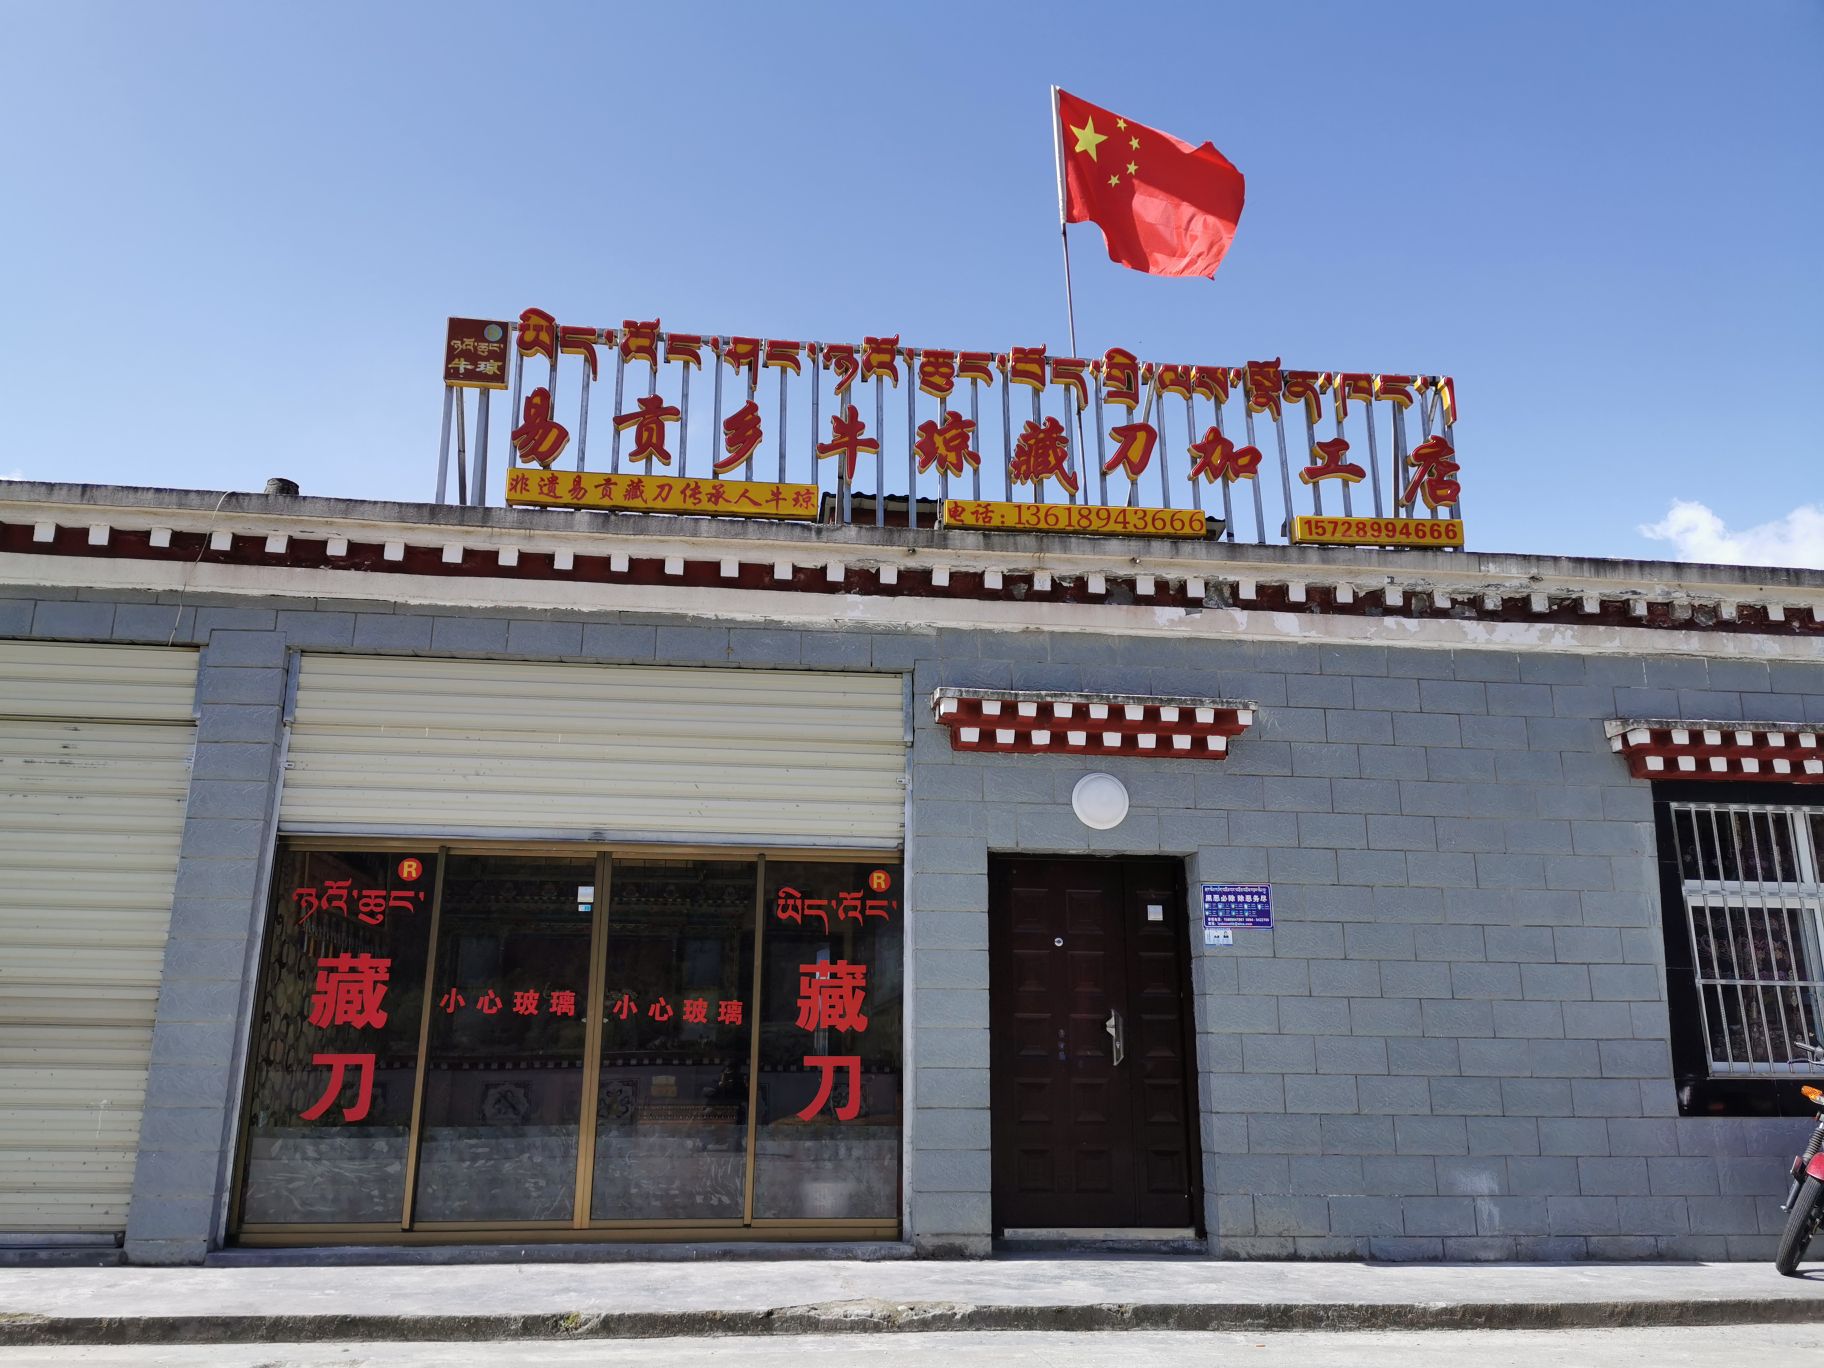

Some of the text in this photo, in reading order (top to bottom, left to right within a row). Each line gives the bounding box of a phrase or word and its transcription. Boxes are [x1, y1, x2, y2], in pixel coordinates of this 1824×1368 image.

[511, 386, 1461, 510] 易贡乡牛琼藏刀加工店
[509, 474, 816, 511] 非遗易贡藏刀传承人牛琼
[1303, 519, 1458, 541] 15728994666
[439, 987, 577, 1017] 小心玻璃
[612, 994, 744, 1026] 小心玻璃
[299, 953, 393, 1122] 藏刀
[795, 960, 869, 1122] 藏刀
